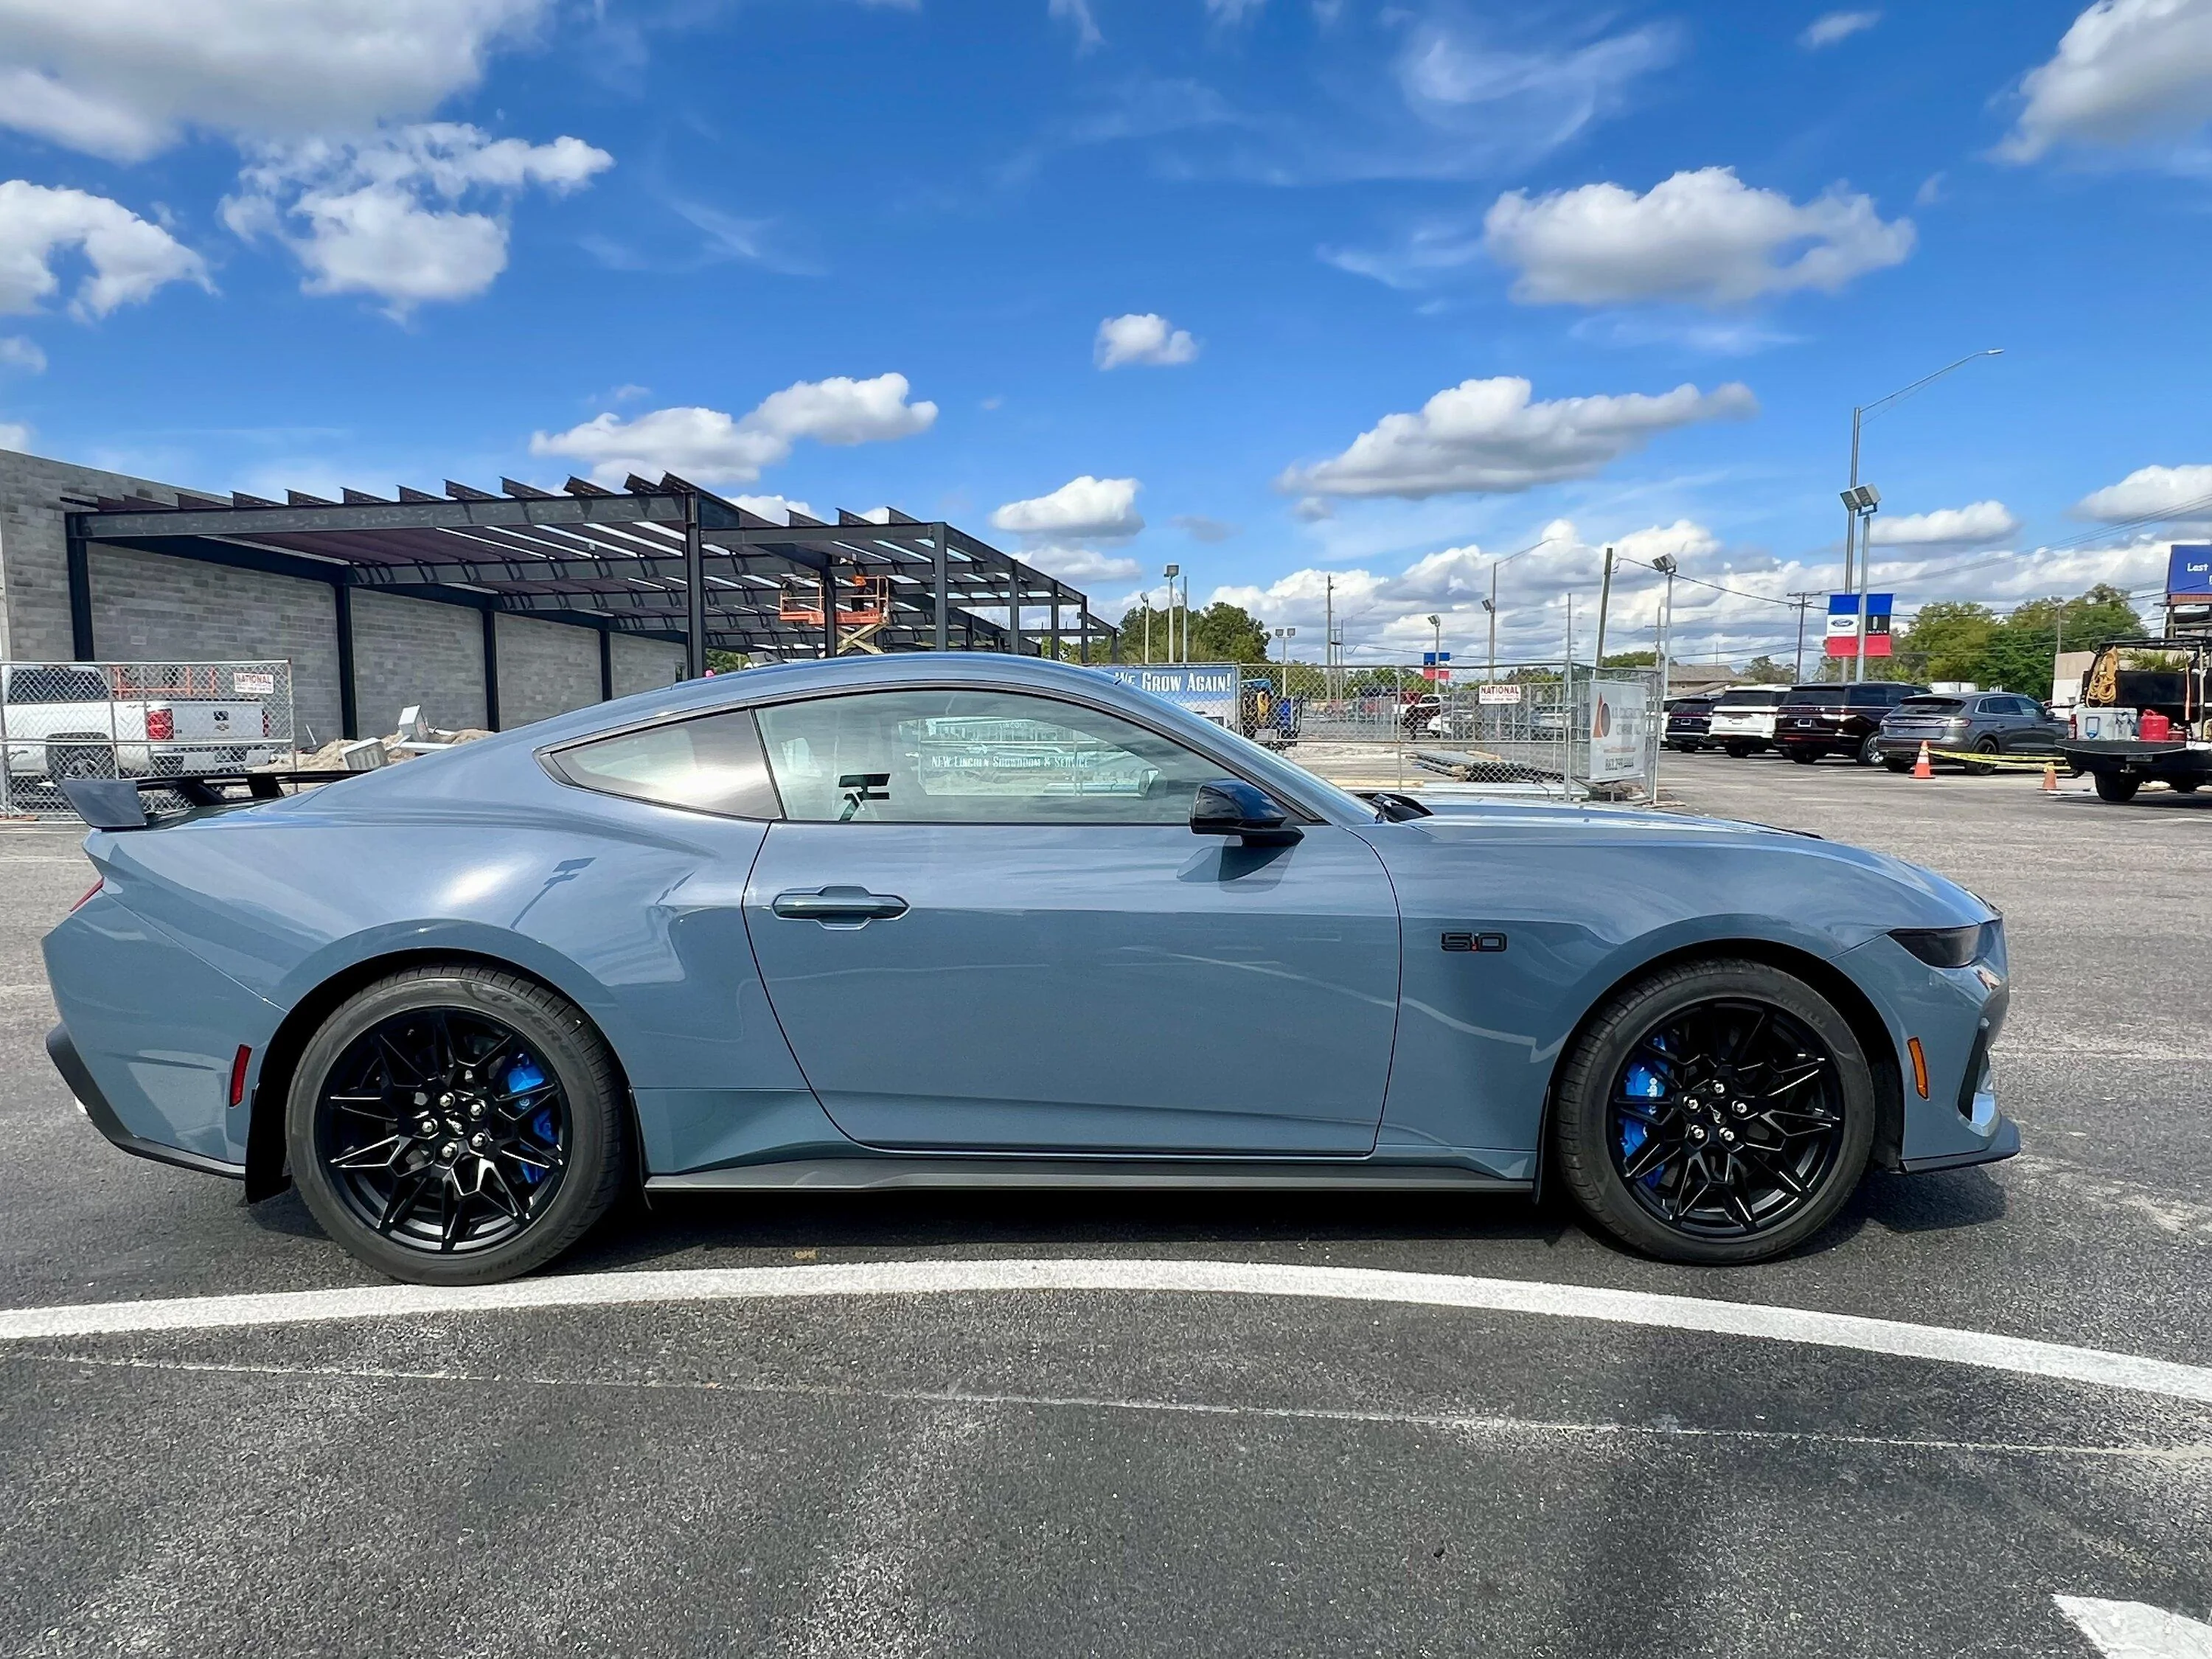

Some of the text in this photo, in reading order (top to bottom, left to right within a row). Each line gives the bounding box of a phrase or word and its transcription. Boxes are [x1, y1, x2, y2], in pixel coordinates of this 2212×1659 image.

[236, 675, 271, 684] NATIONAL
[1142, 672, 1182, 692] GROW
[1187, 672, 1231, 692] AGAIN!
[1481, 686, 1519, 694] NATIONAL
[932, 757, 951, 767] NEW
[1441, 931, 1508, 953] 5.0
